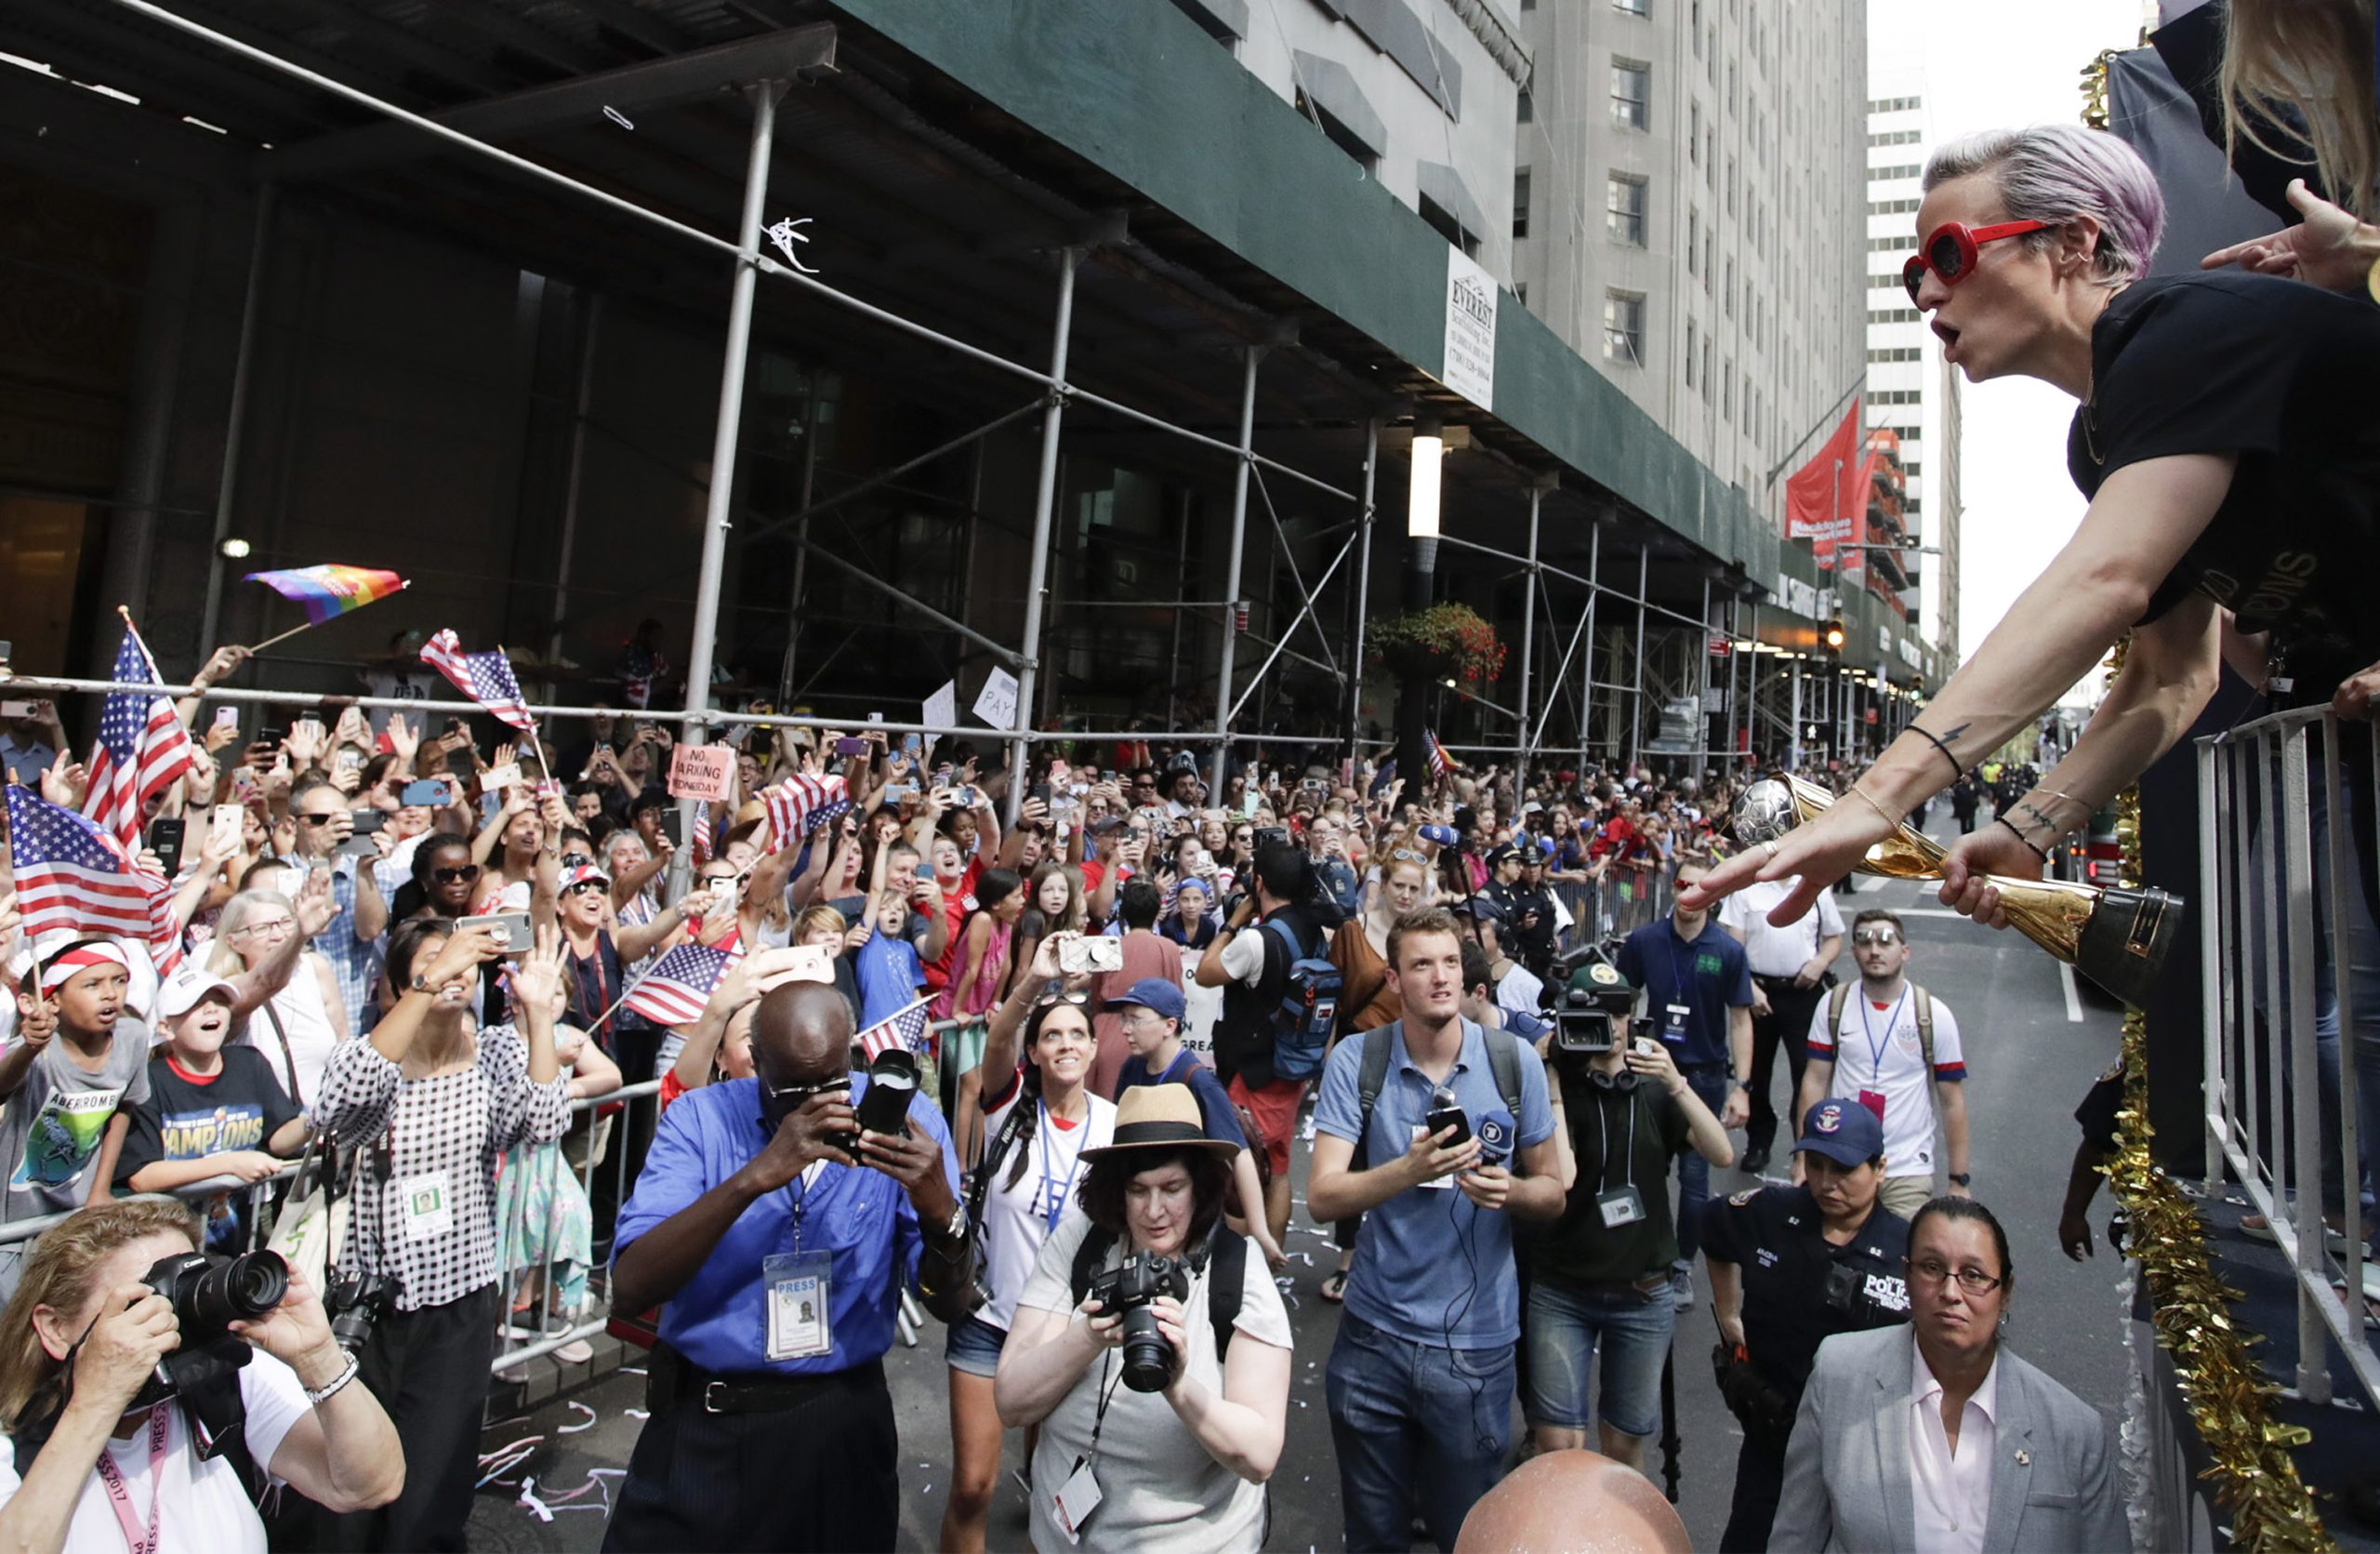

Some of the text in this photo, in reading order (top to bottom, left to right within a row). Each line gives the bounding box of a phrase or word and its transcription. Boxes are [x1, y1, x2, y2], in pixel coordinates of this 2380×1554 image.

[1453, 280, 1492, 328] EVEREST
[690, 750, 706, 763] NO
[1181, 1040, 1214, 1052] GREA
[50, 1093, 118, 1109] ABERCROMB
[183, 1256, 206, 1268] Canon
[778, 1279, 816, 1295] PRESS
[1866, 1274, 1909, 1300] POLIC
[152, 1413, 165, 1453] PRESS
[107, 1472, 127, 1501] 2017
[146, 1522, 159, 1554] RESS
